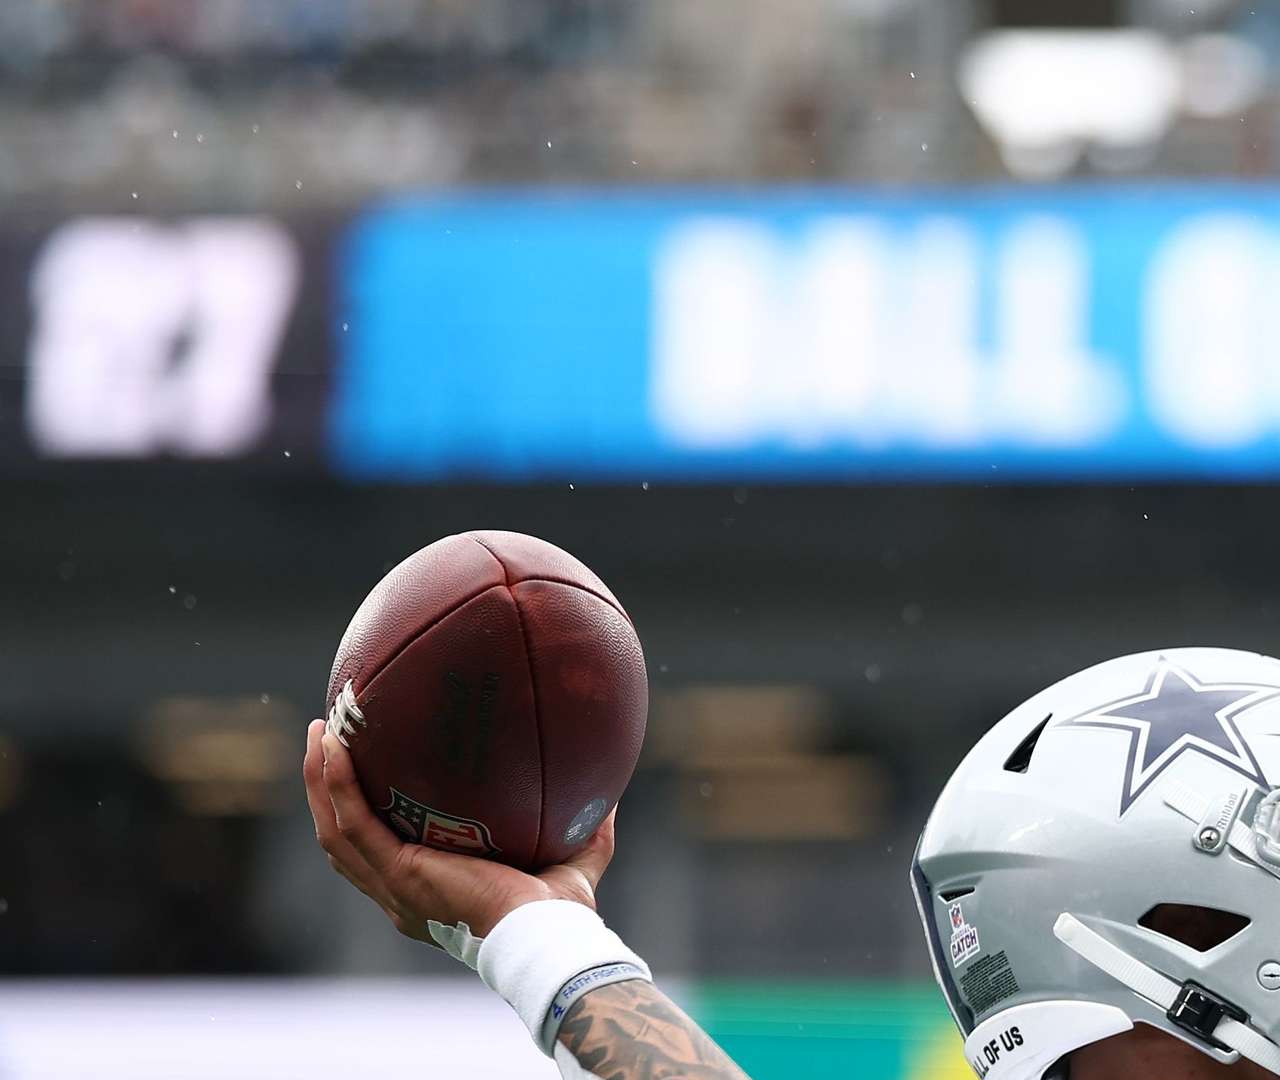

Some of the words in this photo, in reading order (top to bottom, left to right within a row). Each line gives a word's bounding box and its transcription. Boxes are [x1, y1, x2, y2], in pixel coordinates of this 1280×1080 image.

[648, 212, 1130, 452] BALL
[952, 929, 978, 959] CATCH
[562, 975, 592, 999] FAITH
[983, 1038, 1000, 1065] OF
[999, 1026, 1024, 1052] US
